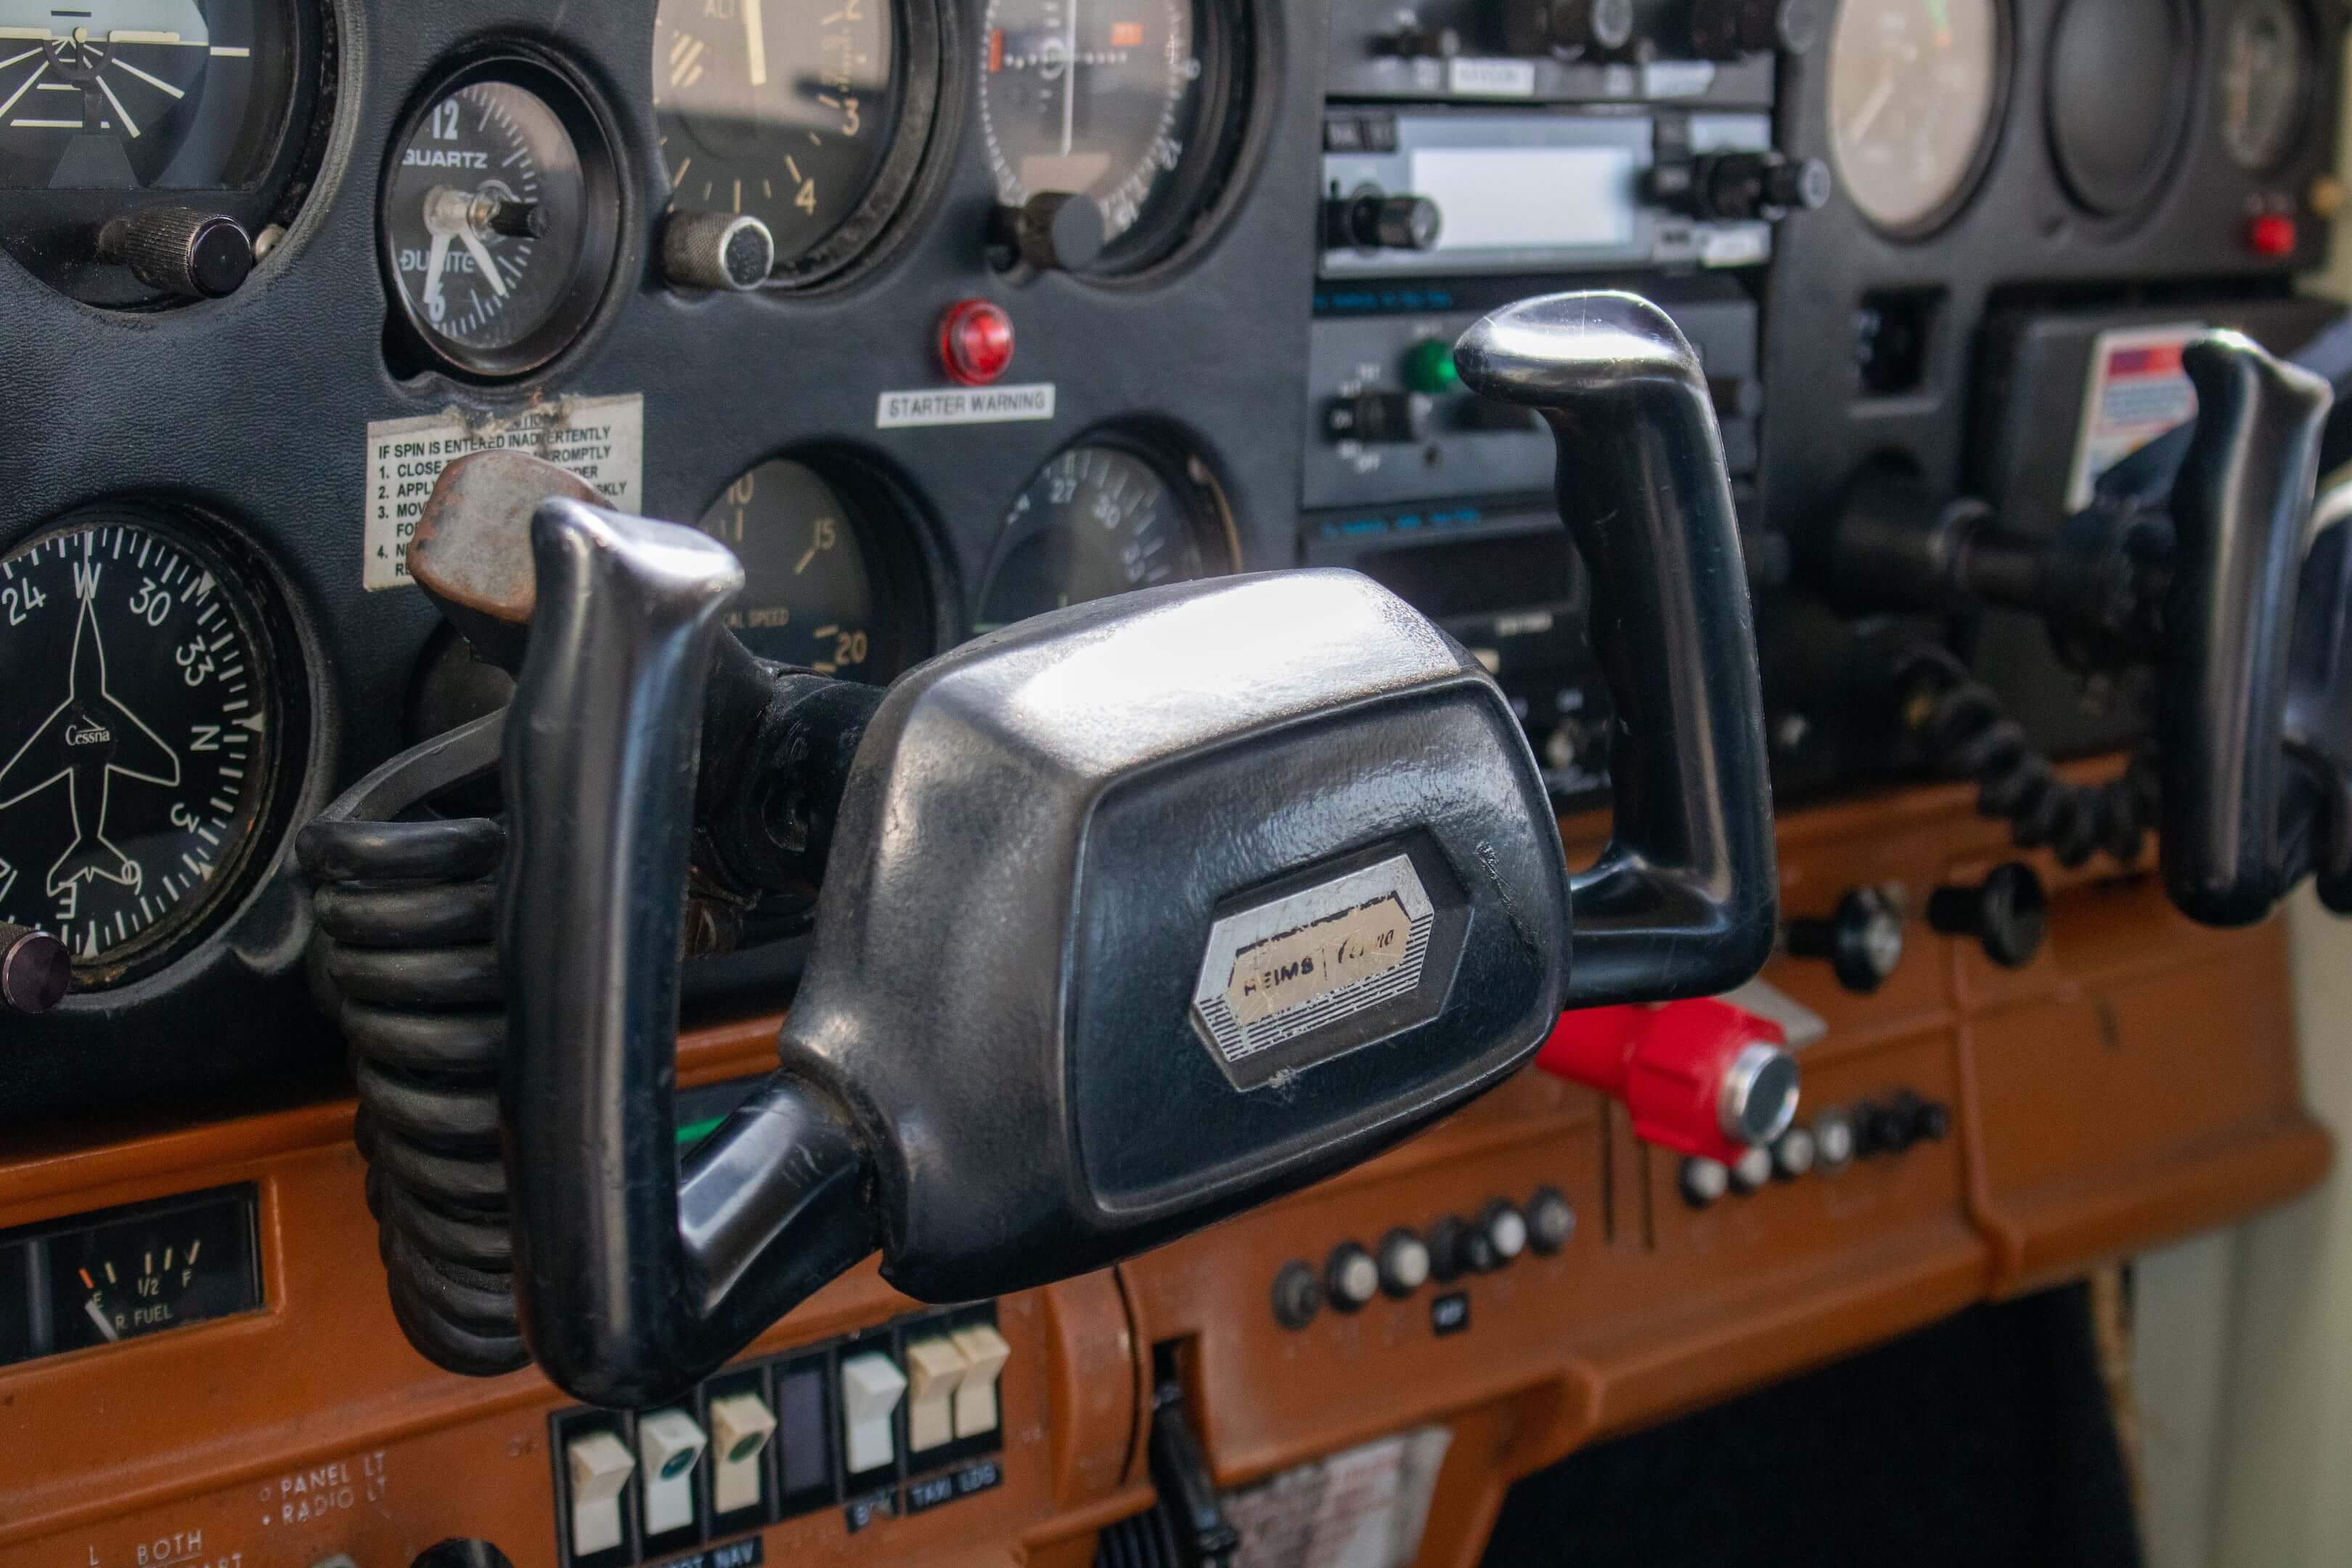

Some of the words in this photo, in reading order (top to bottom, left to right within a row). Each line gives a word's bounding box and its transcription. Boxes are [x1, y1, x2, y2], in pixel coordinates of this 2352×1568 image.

[433, 99, 460, 140] 12
[842, 97, 860, 136] 3
[793, 178, 816, 216] 4
[428, 278, 446, 322] 6
[889, 396, 966, 418] STARTER
[971, 390, 1046, 412] WARNING
[379, 445, 391, 460] IF
[394, 441, 425, 458] SPIN
[428, 441, 441, 456] IS
[444, 436, 505, 454] ENTERED
[546, 444, 612, 462] ROMPTLY
[379, 465, 390, 480] 1.
[397, 460, 442, 478] CLOSE
[378, 485, 390, 499] 2.
[727, 472, 754, 505] 10
[1050, 476, 1077, 503] 27
[377, 505, 390, 520] 3.
[397, 502, 426, 518] MOV
[813, 519, 836, 551] 15
[377, 545, 389, 559] 4.
[73, 562, 102, 599] W
[1, 578, 47, 626] 24
[129, 577, 171, 627] 30
[176, 635, 216, 687] 33
[836, 630, 867, 666] 20
[65, 724, 111, 746] Cessna
[189, 725, 221, 751] N
[170, 802, 200, 834] 3
[56, 881, 78, 920] E
[138, 1277, 160, 1297] 1/2
[182, 1269, 193, 1289] F
[115, 1313, 128, 1331] R
[134, 1304, 174, 1326] FUEL
[280, 1462, 351, 1499] PANEL
[363, 1451, 387, 1477] LT
[282, 1487, 356, 1524] RADIO
[366, 1474, 389, 1502] LT
[89, 1545, 100, 1567] L
[137, 1529, 204, 1566] BOTH
[714, 1540, 755, 1568] NAV
